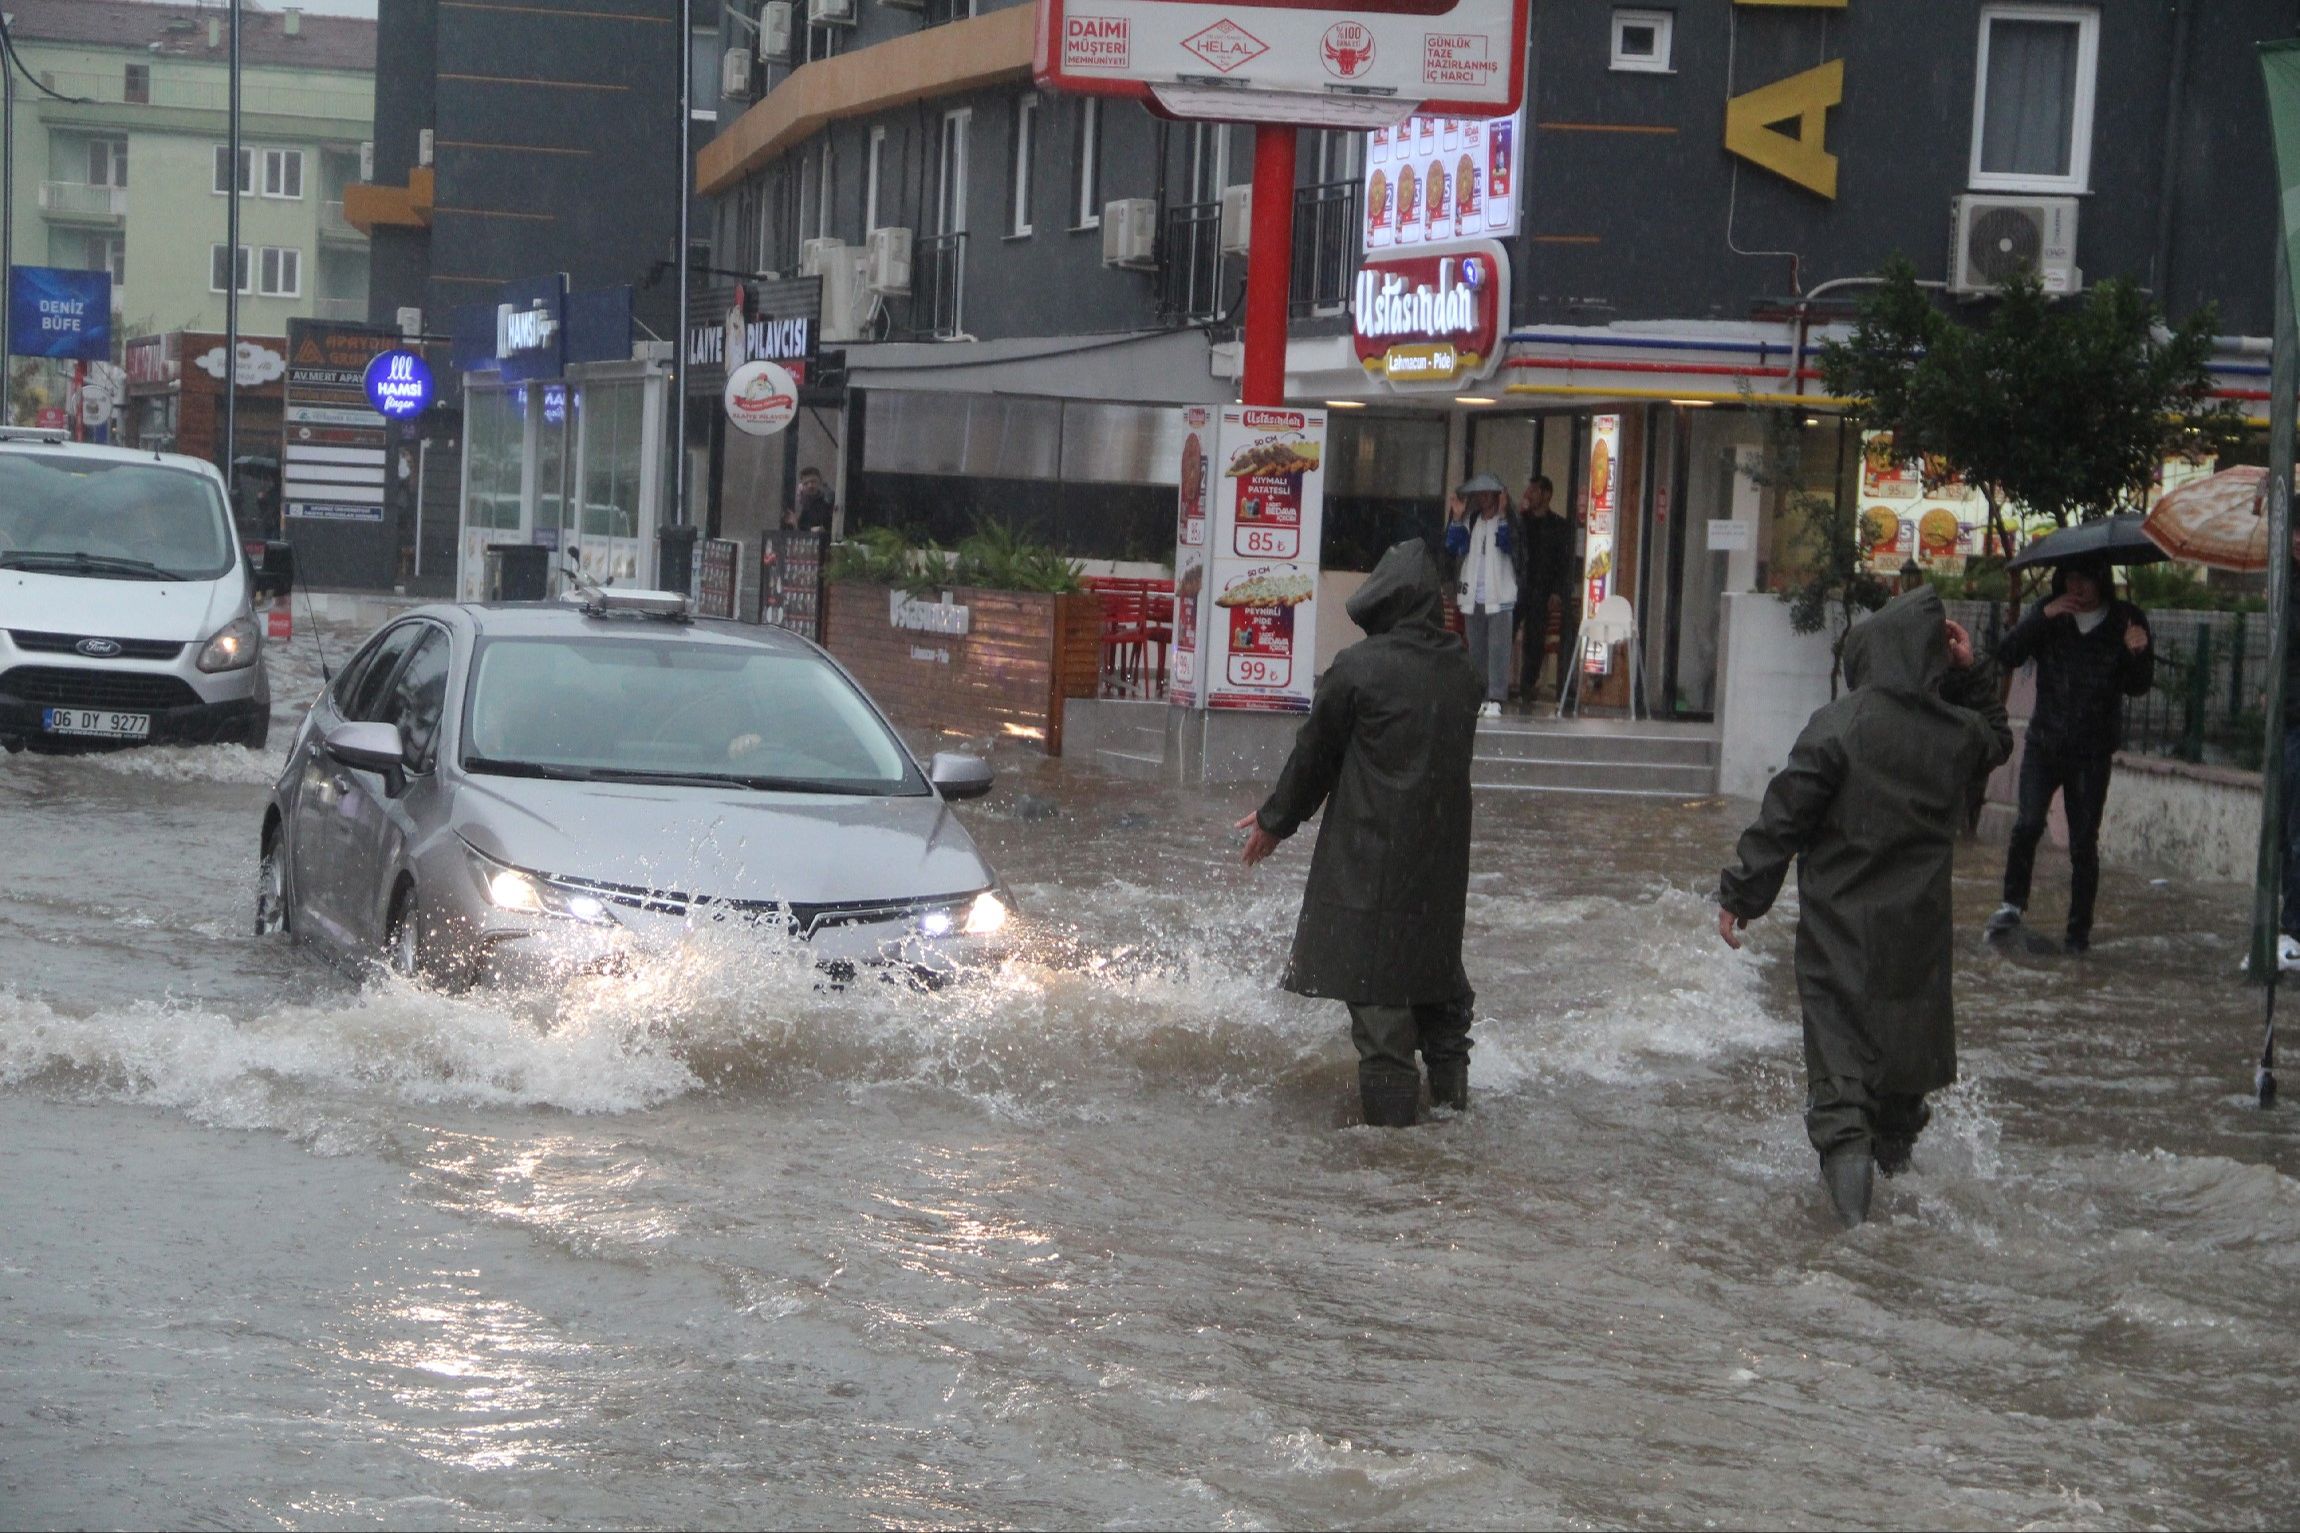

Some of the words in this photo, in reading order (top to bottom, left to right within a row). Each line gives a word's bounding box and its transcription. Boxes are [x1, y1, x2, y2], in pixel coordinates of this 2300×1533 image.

[1069, 17, 1127, 38] DAİMİ
[1068, 38, 1126, 55] MÜŞTERİ
[1197, 40, 1253, 54] HELAL
[1427, 36, 1471, 48] GÜNLÜK
[1427, 48, 1453, 58] TAZE
[1426, 59, 1498, 73] HAZIRLANMIŞ
[1440, 71, 1474, 81] HARCI
[40, 298, 84, 315] DENİZ
[42, 315, 81, 331] BÜFE
[1433, 352, 1451, 369] Pide
[377, 380, 422, 397] HAMSİ
[384, 396, 415, 413] finger
[1254, 438, 1264, 447] 50
[1265, 435, 1278, 444] CM
[1252, 476, 1287, 485] KIYMALI
[1248, 485, 1290, 495] PATATESLİ
[1248, 532, 1273, 551] 85
[1258, 566, 1271, 574] CM
[86, 640, 111, 652] Ford
[1240, 661, 1266, 681] 99
[53, 711, 71, 727] 06
[82, 712, 100, 729] DY
[110, 715, 147, 732] 9277
